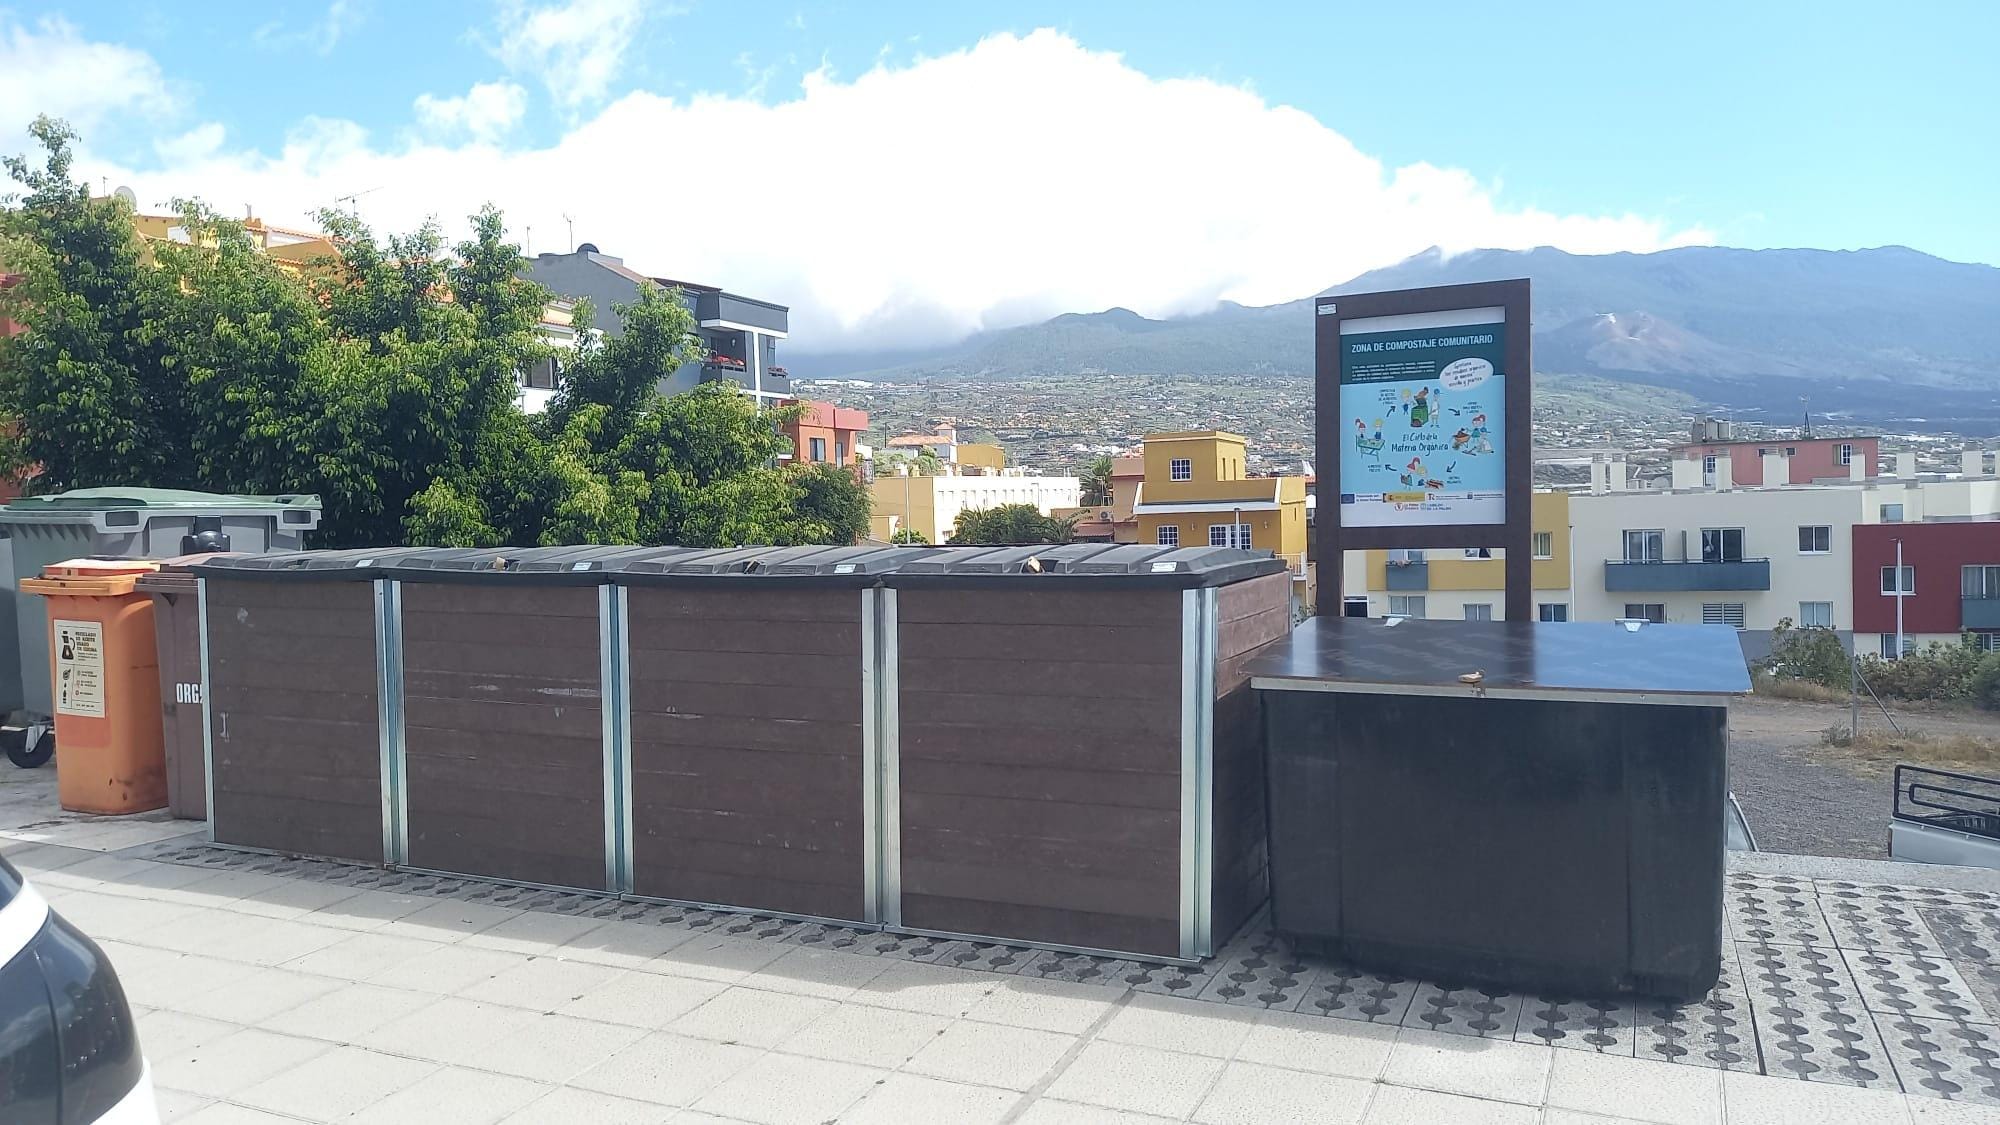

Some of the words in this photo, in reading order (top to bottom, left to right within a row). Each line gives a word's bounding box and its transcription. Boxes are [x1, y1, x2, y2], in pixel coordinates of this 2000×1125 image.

[1351, 343, 1372, 353] ZONA
[1374, 342, 1385, 352] DE
[1385, 338, 1437, 351] COMPOSTAJE
[1438, 334, 1493, 347] COMUNITARIO
[1391, 443, 1417, 452] Materia
